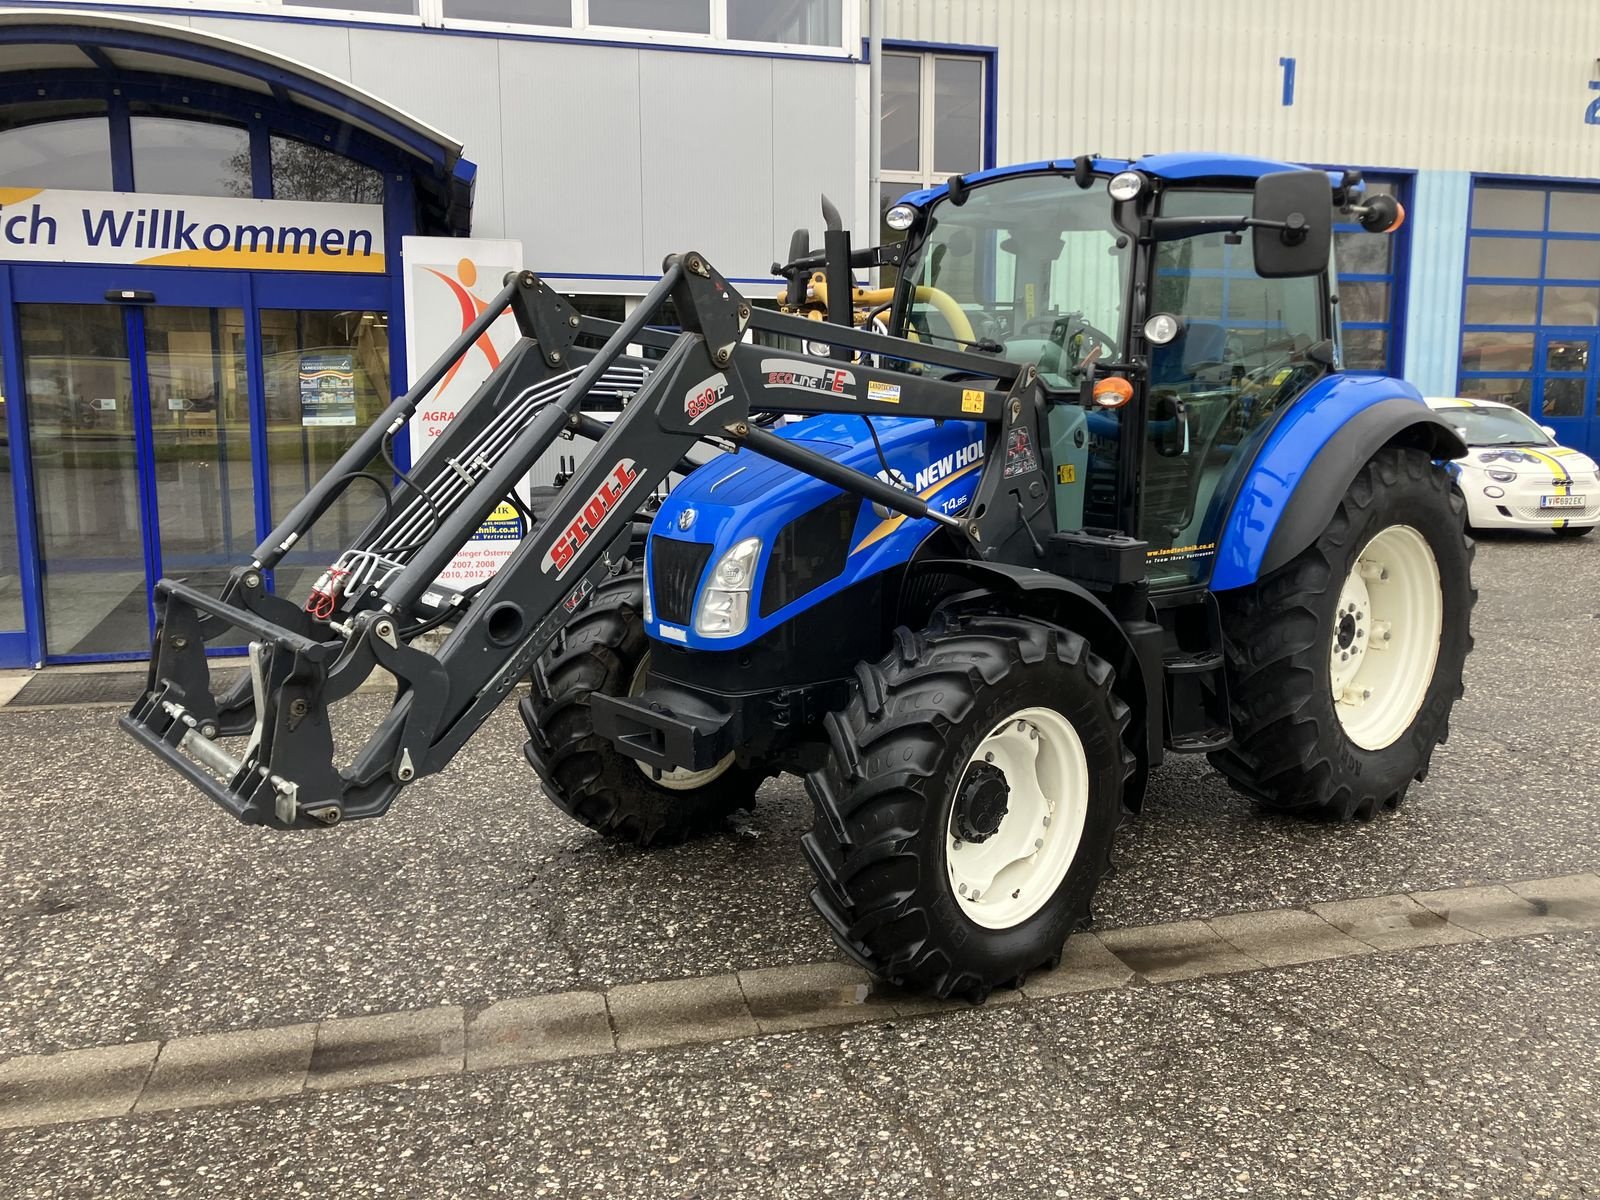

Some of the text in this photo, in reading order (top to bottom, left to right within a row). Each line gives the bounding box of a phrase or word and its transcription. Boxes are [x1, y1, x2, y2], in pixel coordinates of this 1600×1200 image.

[1279, 57, 1295, 106] 1
[81, 208, 373, 257] Willkommen
[820, 369, 846, 392] FE
[687, 386, 716, 418] 850
[915, 453, 954, 493] NEW
[550, 463, 637, 571] STOLL
[942, 494, 968, 514] T4.85
[452, 560, 495, 569] 2007, 2008
